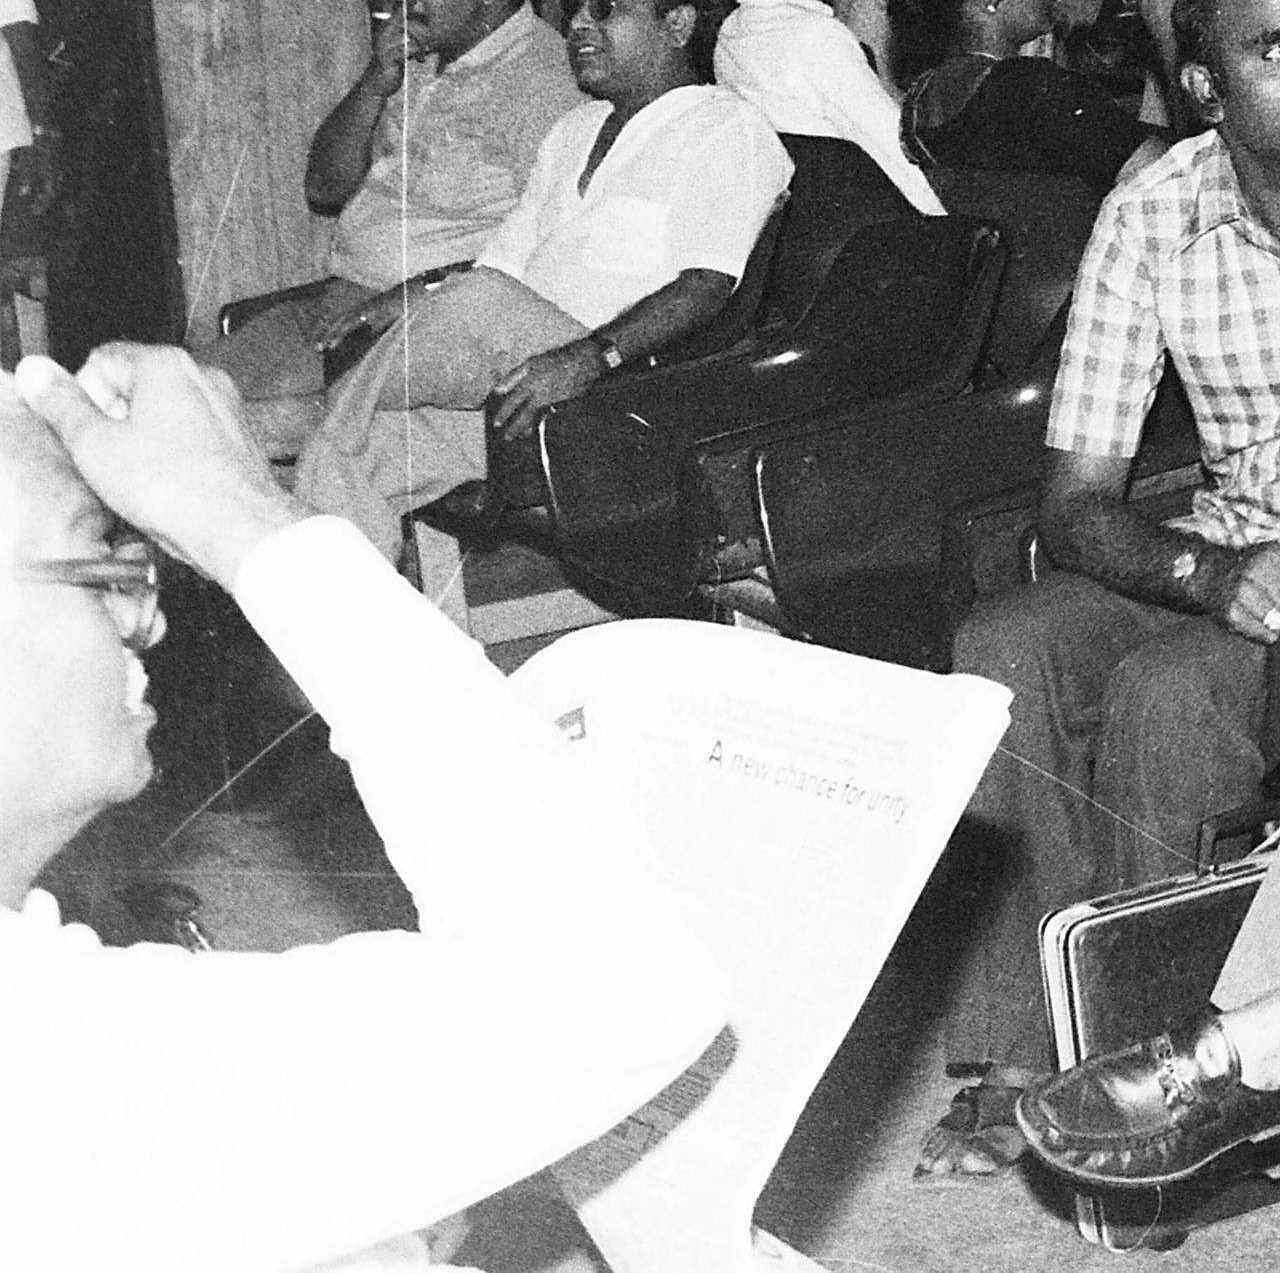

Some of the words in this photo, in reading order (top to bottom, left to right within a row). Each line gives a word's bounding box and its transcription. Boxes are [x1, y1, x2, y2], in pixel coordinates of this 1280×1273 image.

[706, 739, 723, 768] A
[731, 751, 769, 782] new
[841, 776, 867, 806] for
